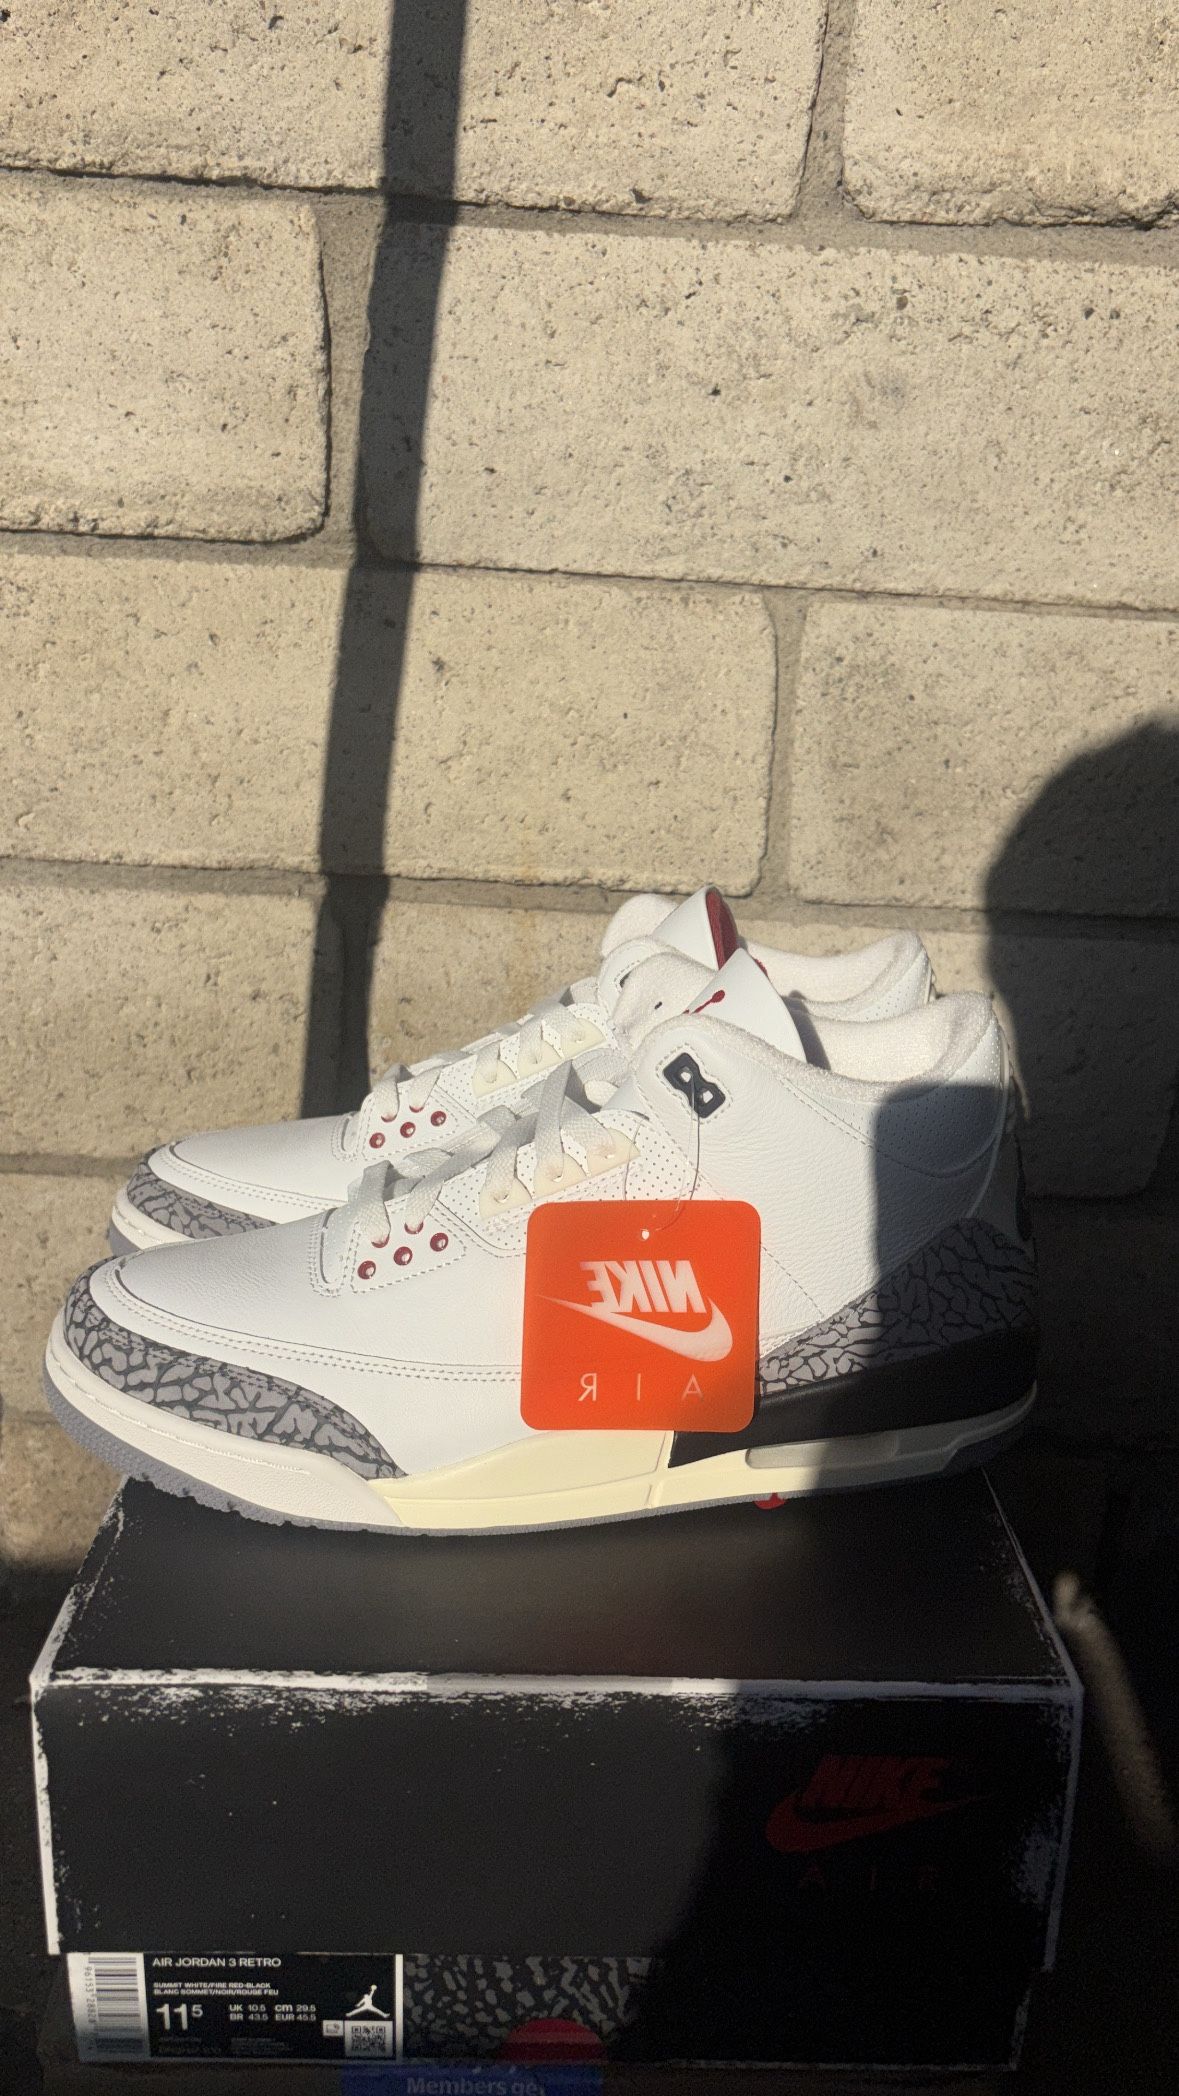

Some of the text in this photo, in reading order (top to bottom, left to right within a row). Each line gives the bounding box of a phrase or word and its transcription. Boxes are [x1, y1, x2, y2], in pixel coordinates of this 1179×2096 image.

[801, 1754, 955, 1808] NIKE
[152, 1957, 282, 1967] AIR JORDAN 3 RETRO
[229, 2004, 316, 2012] UK 10.5 cm 29.5
[229, 2013, 316, 2021] BR 43.5 EUR 45.5
[407, 2077, 507, 2095] Members
